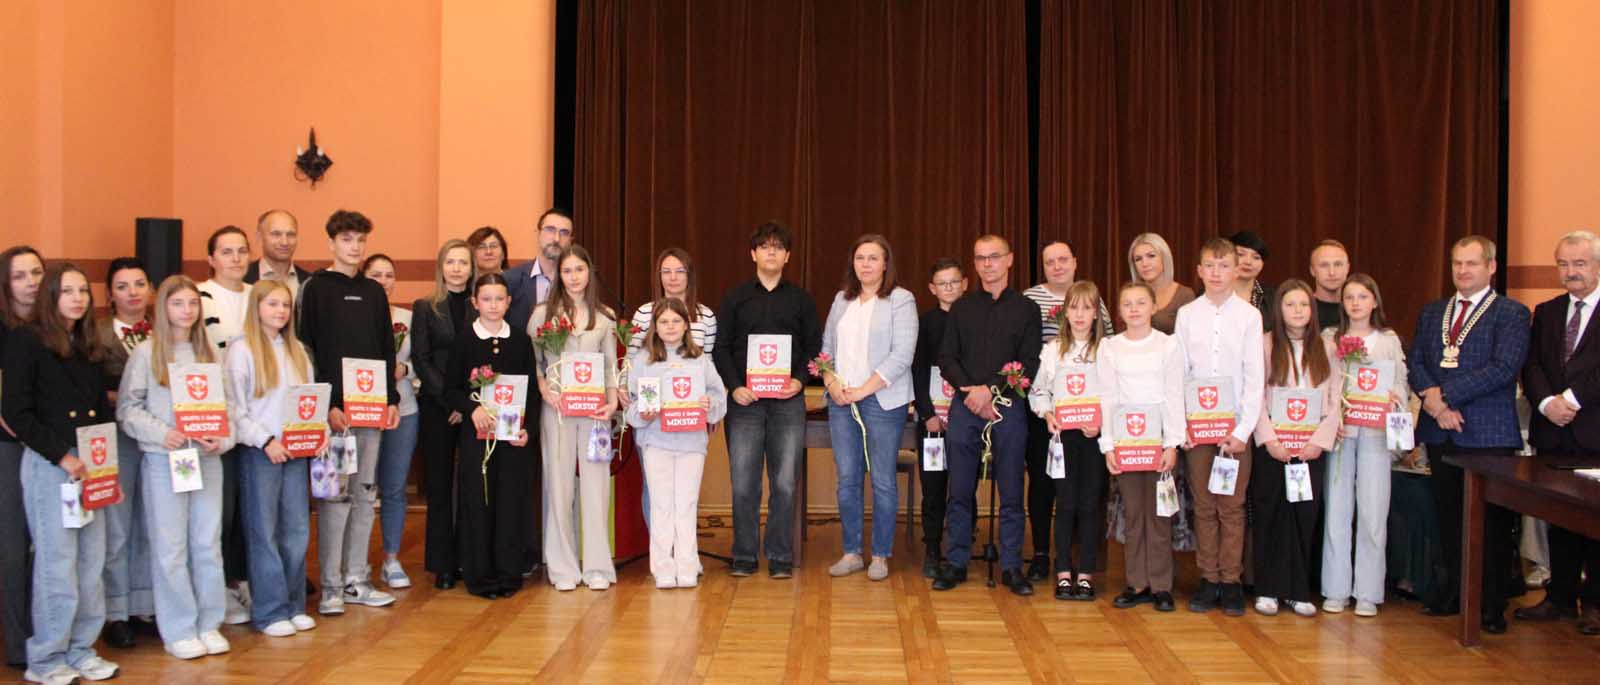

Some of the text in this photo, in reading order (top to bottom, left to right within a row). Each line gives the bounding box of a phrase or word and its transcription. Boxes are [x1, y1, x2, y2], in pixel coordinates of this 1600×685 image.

[568, 402, 598, 410] MIKSTAT
[666, 418, 698, 426] MIKSTAT
[1061, 414, 1094, 423] MIKSTAT
[1194, 430, 1228, 438] MIKSTAT
[1121, 456, 1154, 464] MIKSTAT
